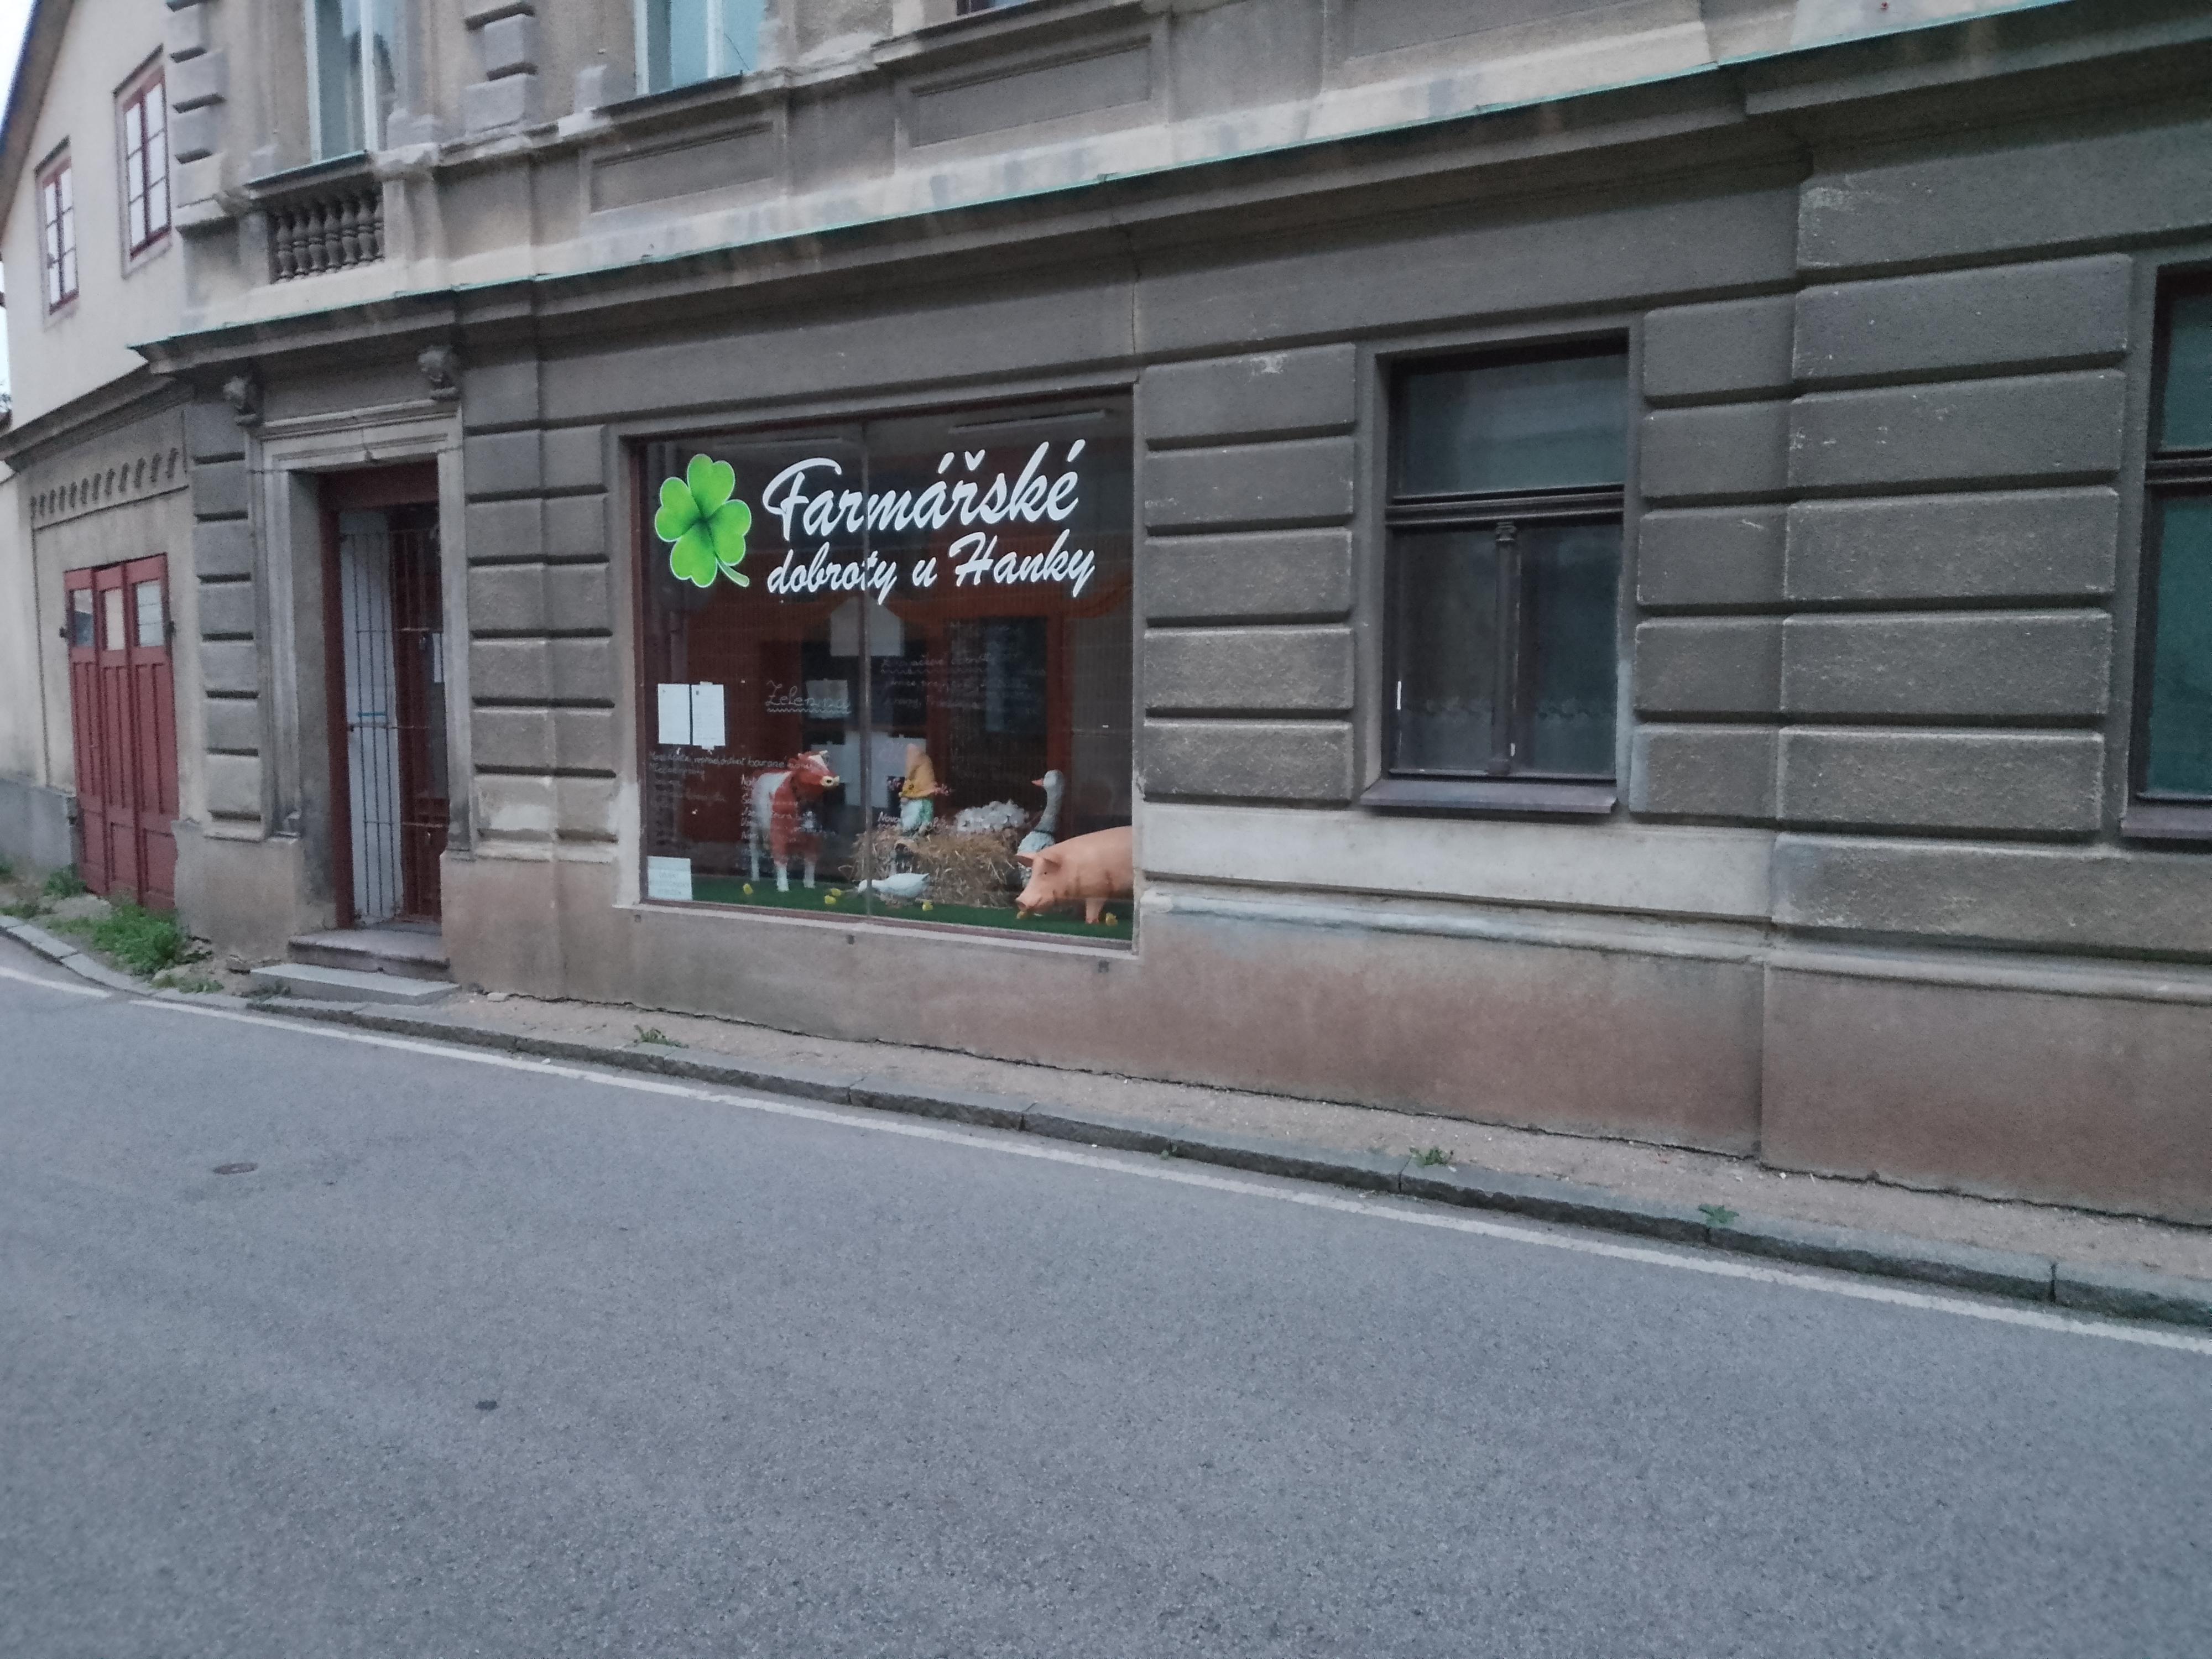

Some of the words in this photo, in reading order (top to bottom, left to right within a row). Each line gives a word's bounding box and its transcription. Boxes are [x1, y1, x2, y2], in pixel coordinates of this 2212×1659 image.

[763, 439, 1086, 541] Farmářské
[767, 541, 898, 605] dobroty
[912, 557, 938, 587] u
[948, 529, 1095, 598] Hanky
